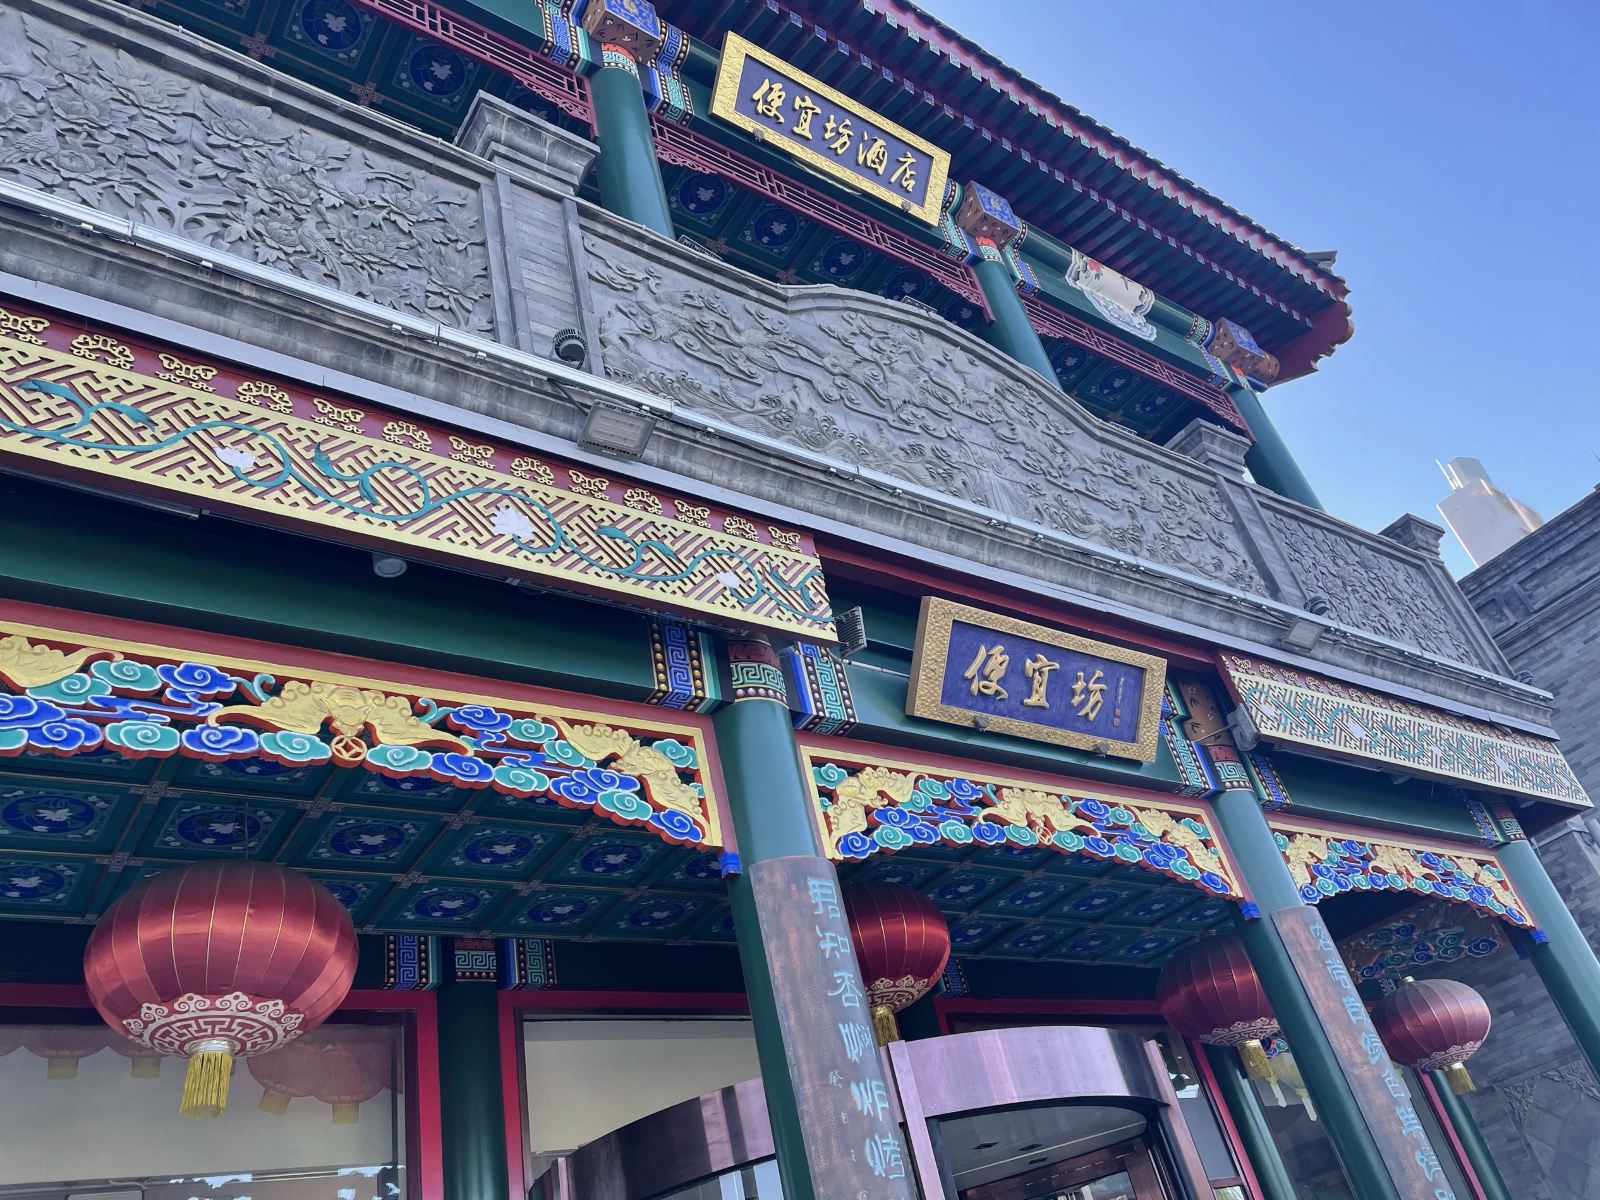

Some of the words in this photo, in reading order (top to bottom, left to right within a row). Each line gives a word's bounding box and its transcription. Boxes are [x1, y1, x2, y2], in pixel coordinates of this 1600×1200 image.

[752, 78, 917, 193] 便宜坊酒店
[963, 643, 1108, 721] 便宜坊
